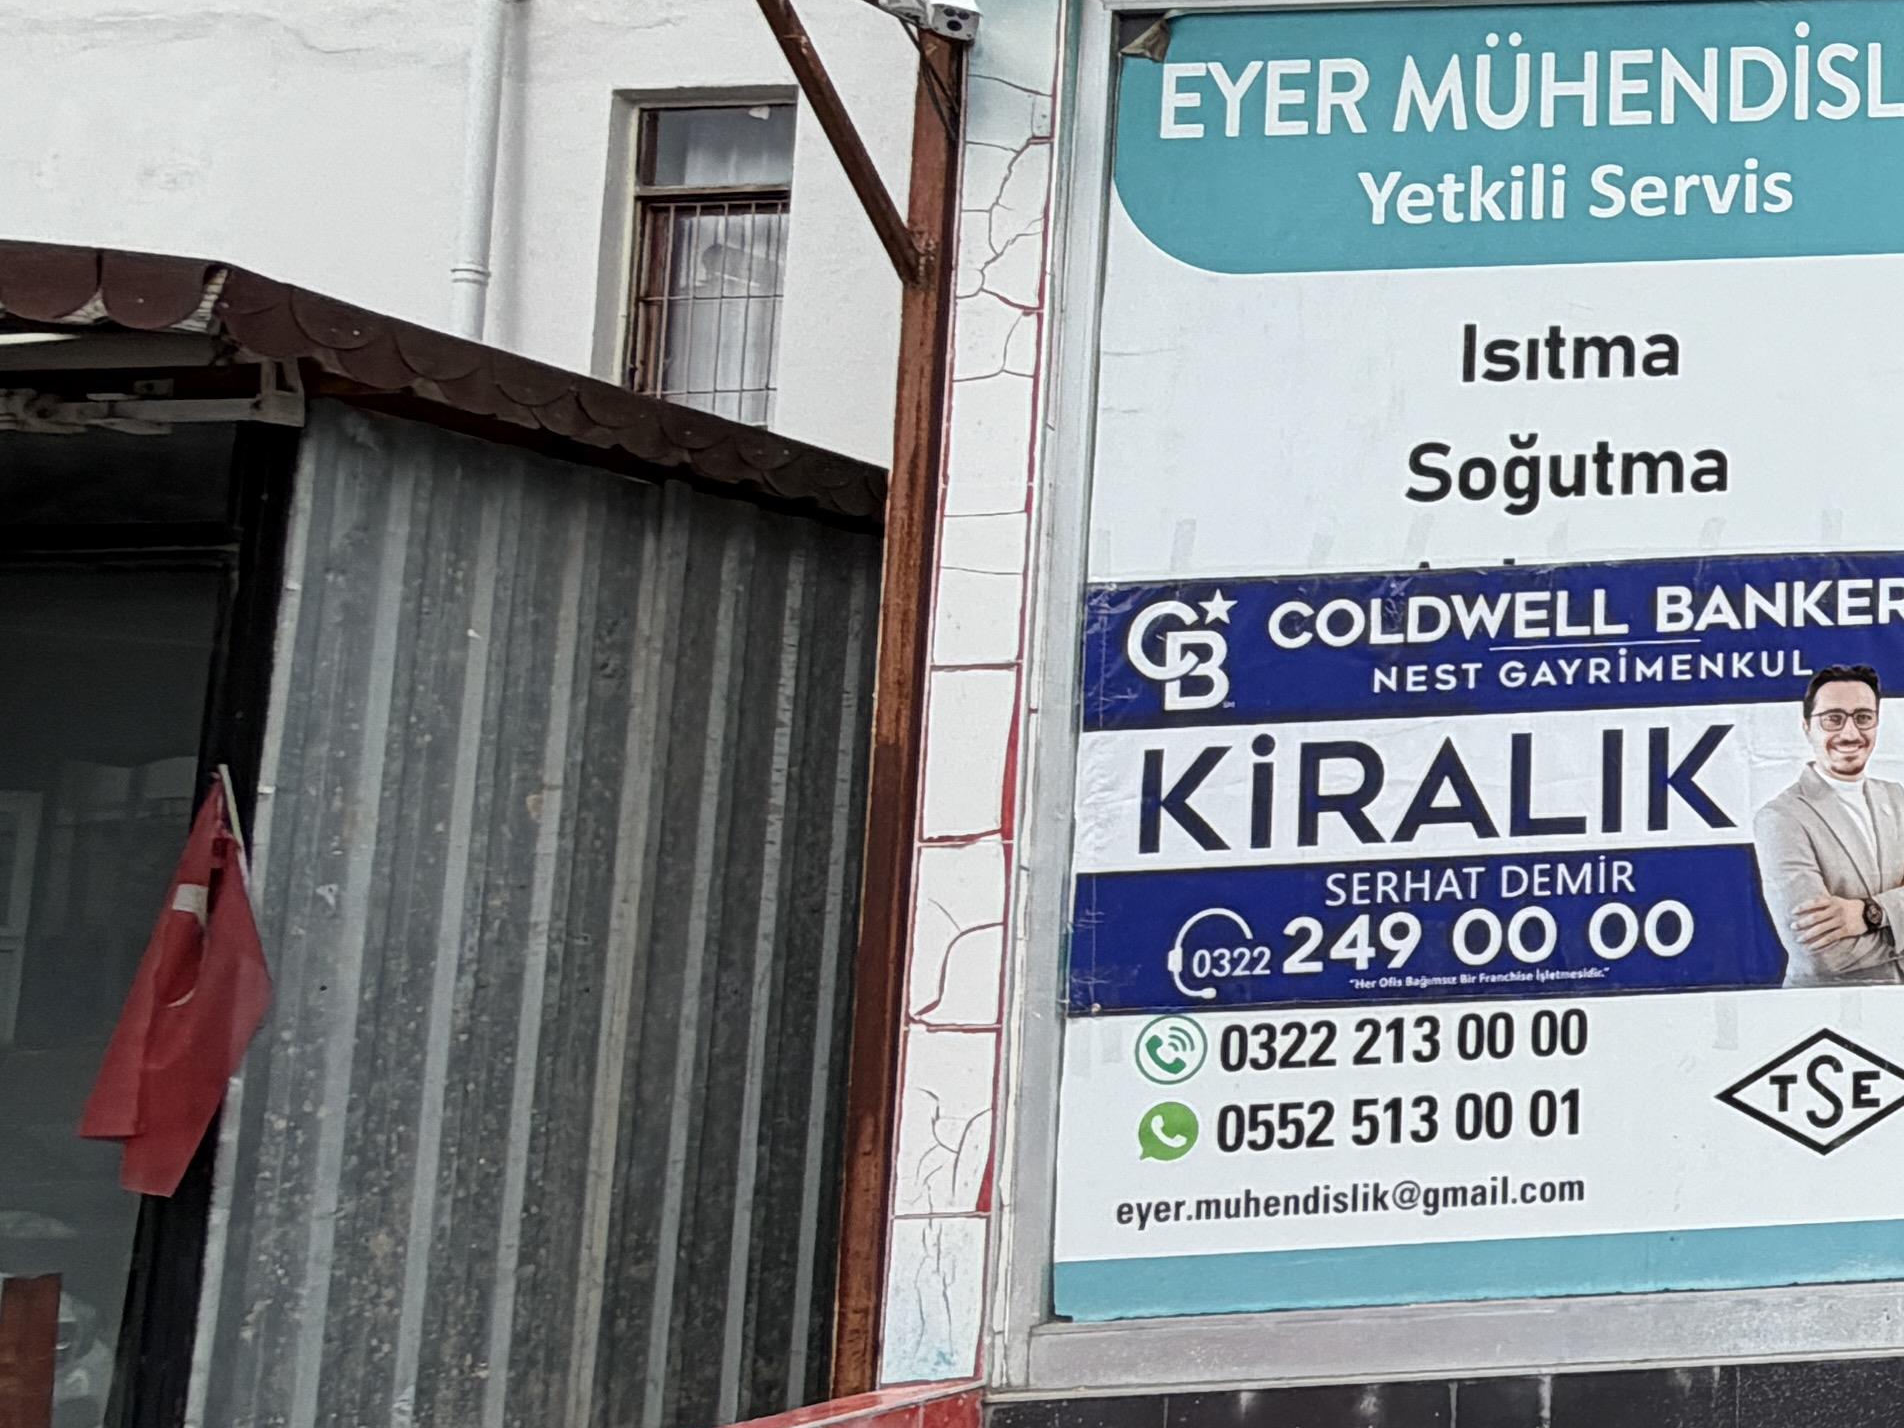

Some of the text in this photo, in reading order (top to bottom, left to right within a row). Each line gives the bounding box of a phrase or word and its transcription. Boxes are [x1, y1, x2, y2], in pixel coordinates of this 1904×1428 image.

[1160, 58, 1367, 139] EYER
[1359, 157, 1794, 226] Yetkili Servis
[1462, 323, 1679, 383] Isıtma
[1405, 432, 1728, 516] Soğutma
[1268, 589, 1628, 649] COLDWELL
[1373, 647, 1813, 695] NEST GAYRİMENKUL
[1325, 856, 1636, 908] SERHAT DEMİR
[1193, 900, 1695, 978] 0322 249 00 00
[1479, 971, 1533, 983] Franchise
[1220, 1008, 1588, 1072] 0322 213 00 00
[1217, 1088, 1580, 1153] 0552 513 00 01
[1769, 1054, 1881, 1129] TSE
[1116, 1176, 1585, 1230] eyer.muhendislik@gmail.com
